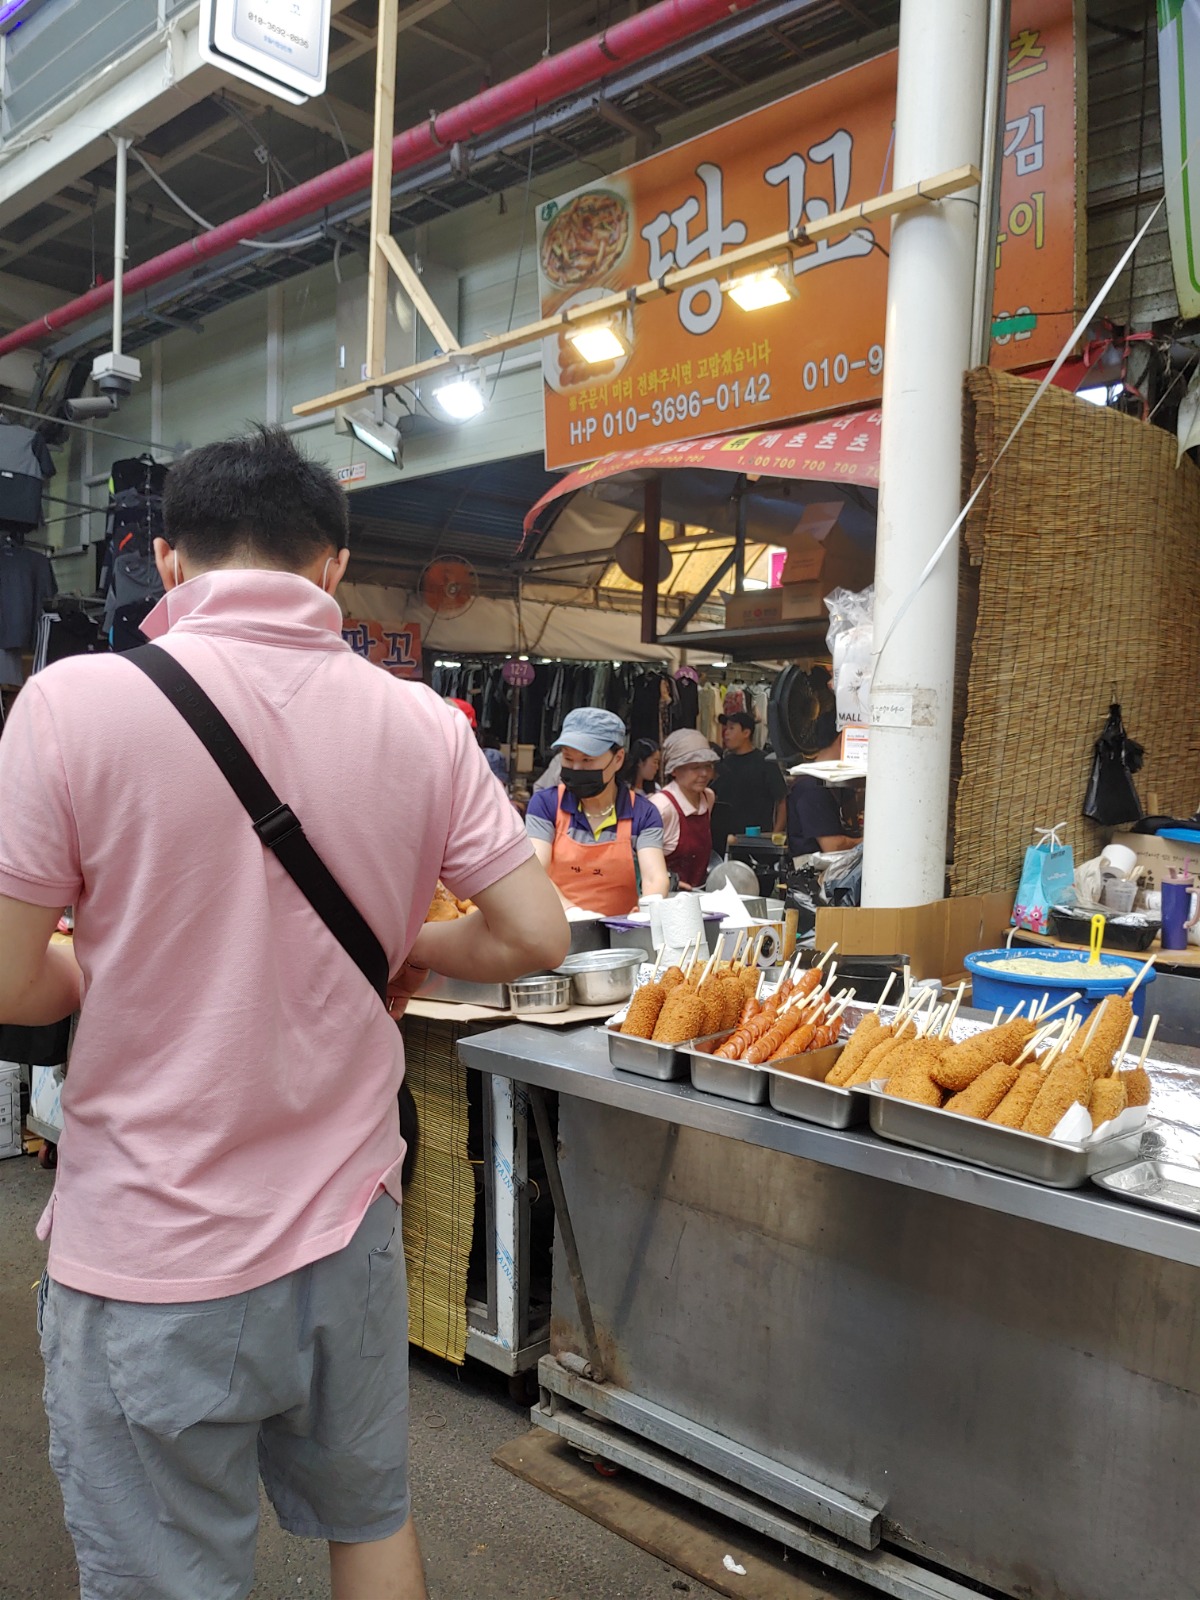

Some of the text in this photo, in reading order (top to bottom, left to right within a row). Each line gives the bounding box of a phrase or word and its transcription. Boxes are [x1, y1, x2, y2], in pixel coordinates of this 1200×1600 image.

[1003, 105, 1046, 177] 김
[612, 376, 633, 402] 미리
[637, 360, 693, 397] 전화주시면
[697, 339, 772, 380] 고맙겠습니다
[602, 373, 771, 438] 010-3696-0142
[773, 457, 796, 469] 700
[802, 460, 826, 472] 700
[832, 462, 857, 474] 700
[838, 712, 862, 722] MALL
